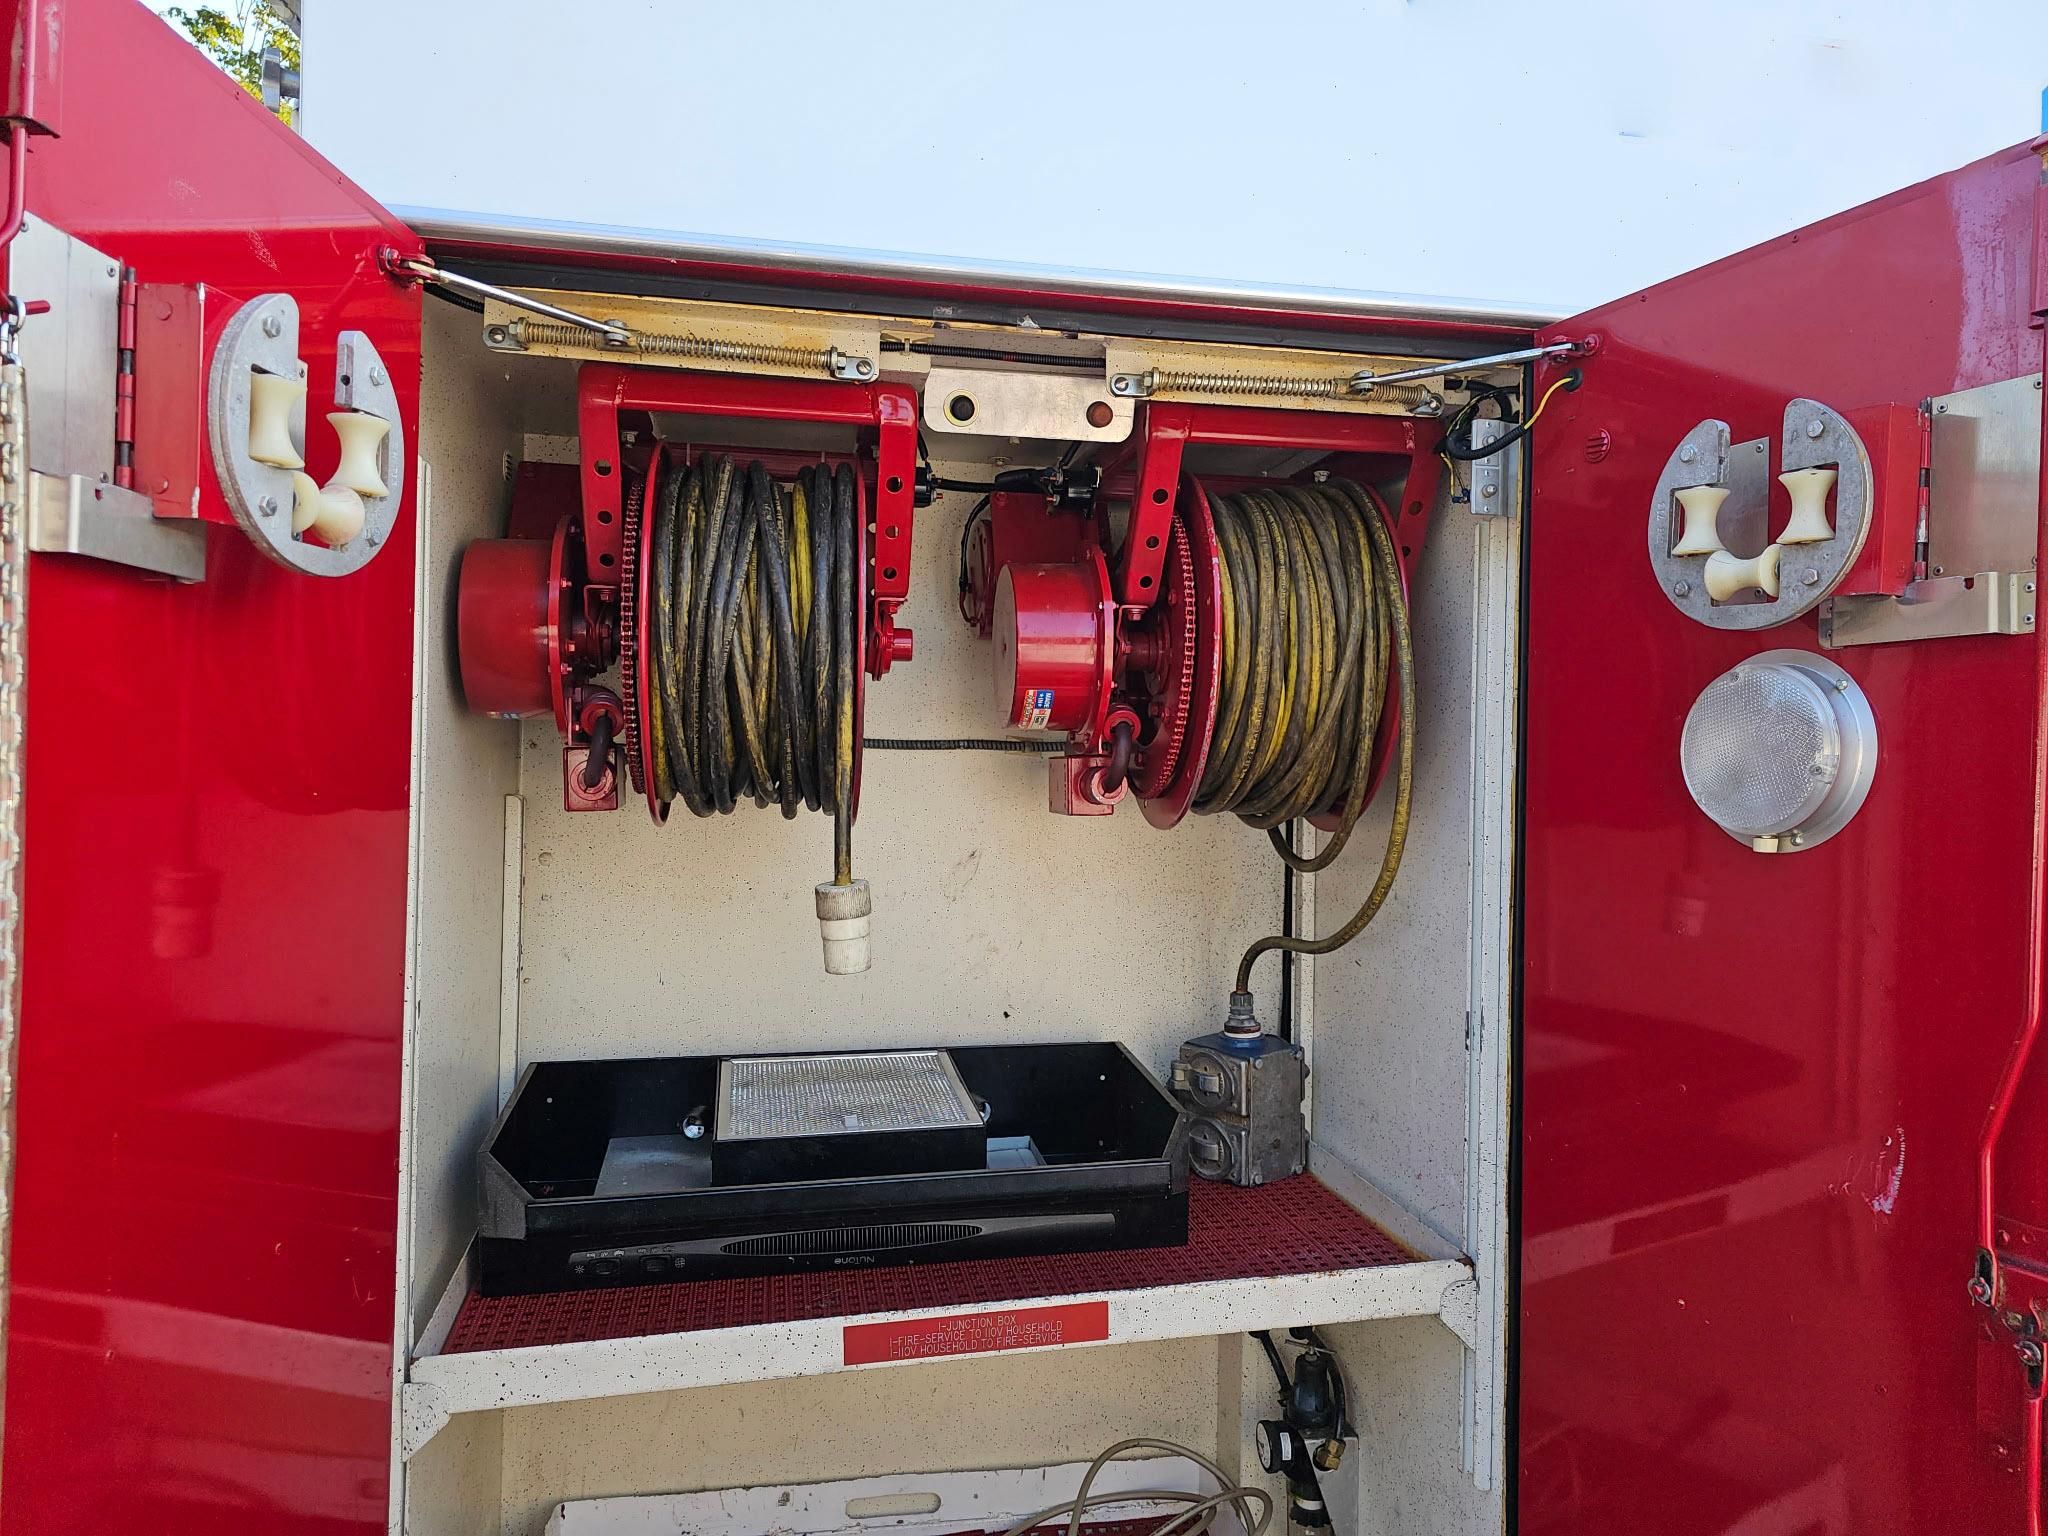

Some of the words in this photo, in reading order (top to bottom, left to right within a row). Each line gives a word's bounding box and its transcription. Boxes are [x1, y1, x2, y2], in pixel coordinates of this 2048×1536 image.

[1044, 692, 1052, 709] MADE
[834, 1255, 875, 1265] NuTone
[997, 1314, 1017, 1326] BOX
[969, 1328, 982, 1339] TO
[1006, 1320, 1063, 1336] HOUSEHOLD
[920, 1339, 978, 1355] HOUSEHOLD
[981, 1338, 994, 1348] TO
[996, 1331, 1063, 1347] FIRE-SERVICE
